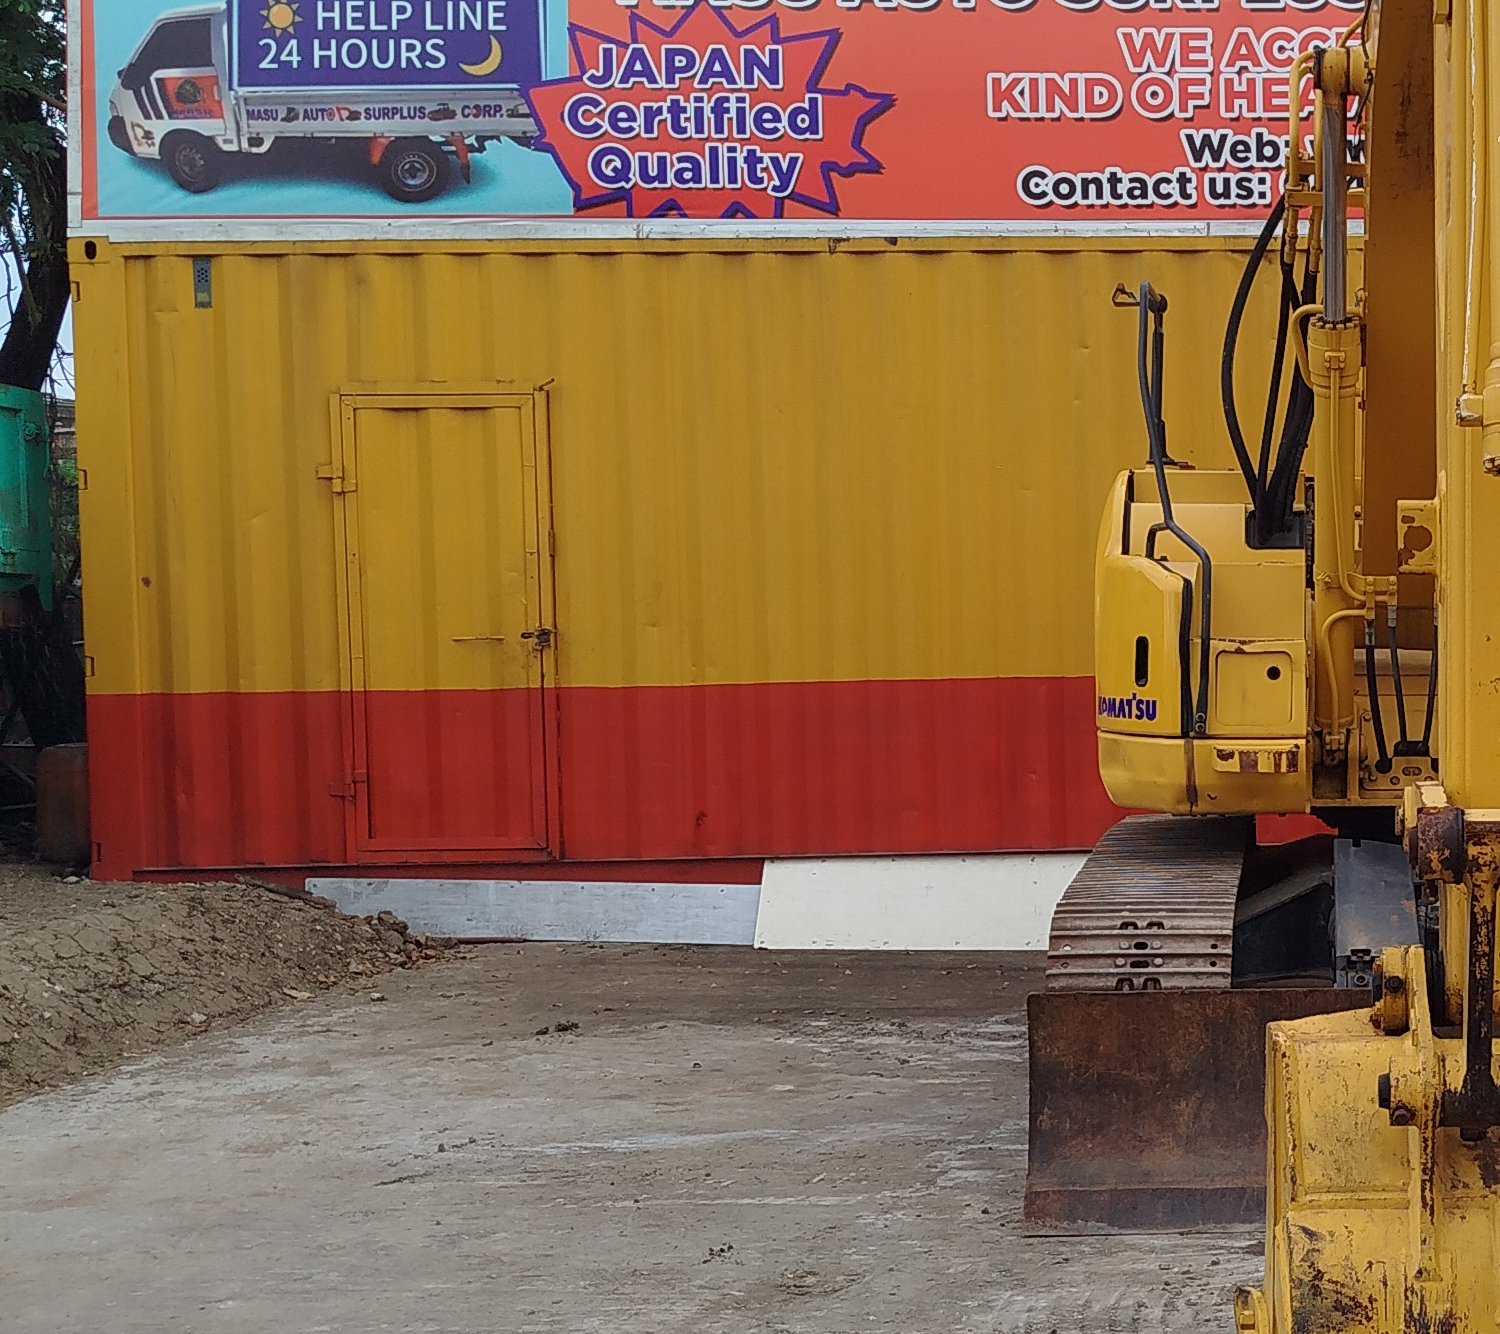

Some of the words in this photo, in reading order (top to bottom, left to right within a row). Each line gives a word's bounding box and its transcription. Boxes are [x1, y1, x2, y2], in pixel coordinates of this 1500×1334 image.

[316, 0, 413, 31] HELP
[425, 0, 507, 31] LINE
[258, 39, 302, 69] 24
[312, 38, 447, 69] HOURS
[585, 44, 784, 90] JAPAN
[1117, 27, 1213, 73] WE
[246, 106, 279, 122] MASU
[363, 105, 427, 122] SURPLUS
[564, 94, 823, 140] Certified
[986, 72, 1123, 119] KIND
[1131, 72, 1211, 120] OF
[588, 144, 803, 198] Quality
[1018, 166, 1197, 206] Contact
[1204, 170, 1271, 206] us:
